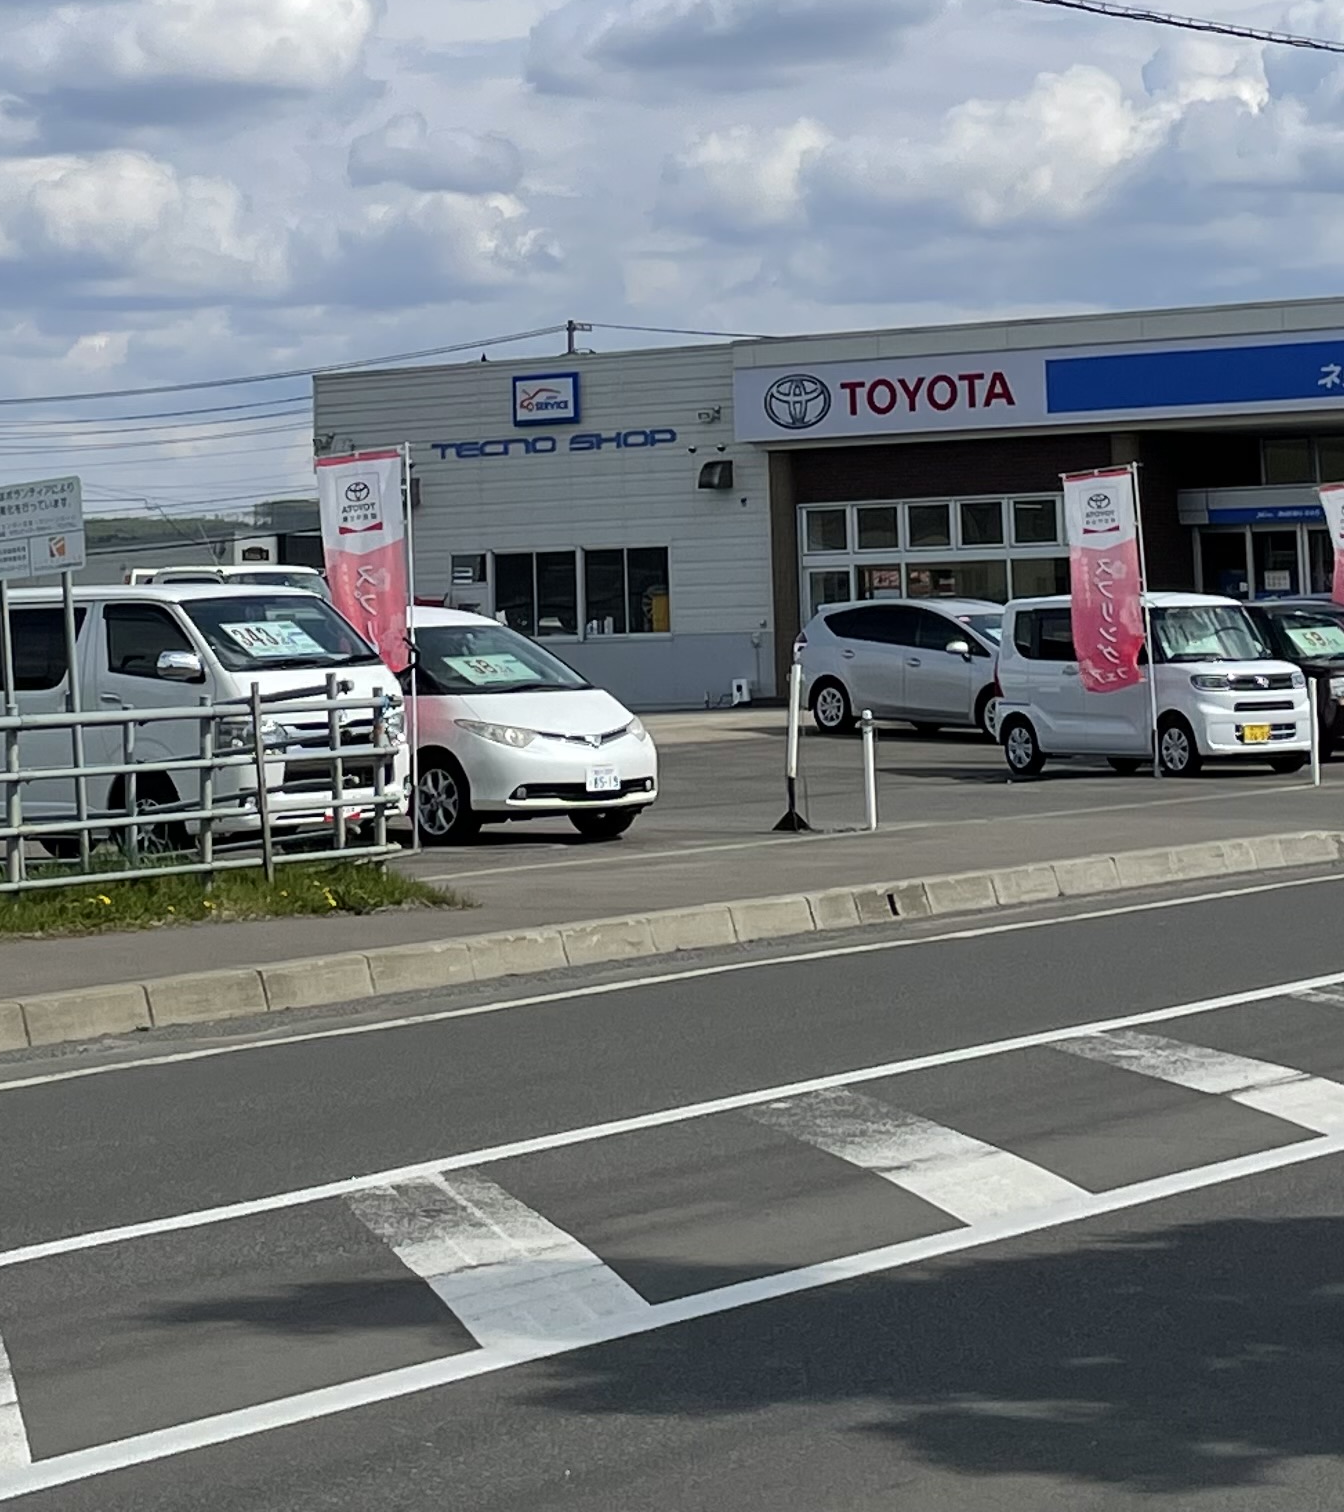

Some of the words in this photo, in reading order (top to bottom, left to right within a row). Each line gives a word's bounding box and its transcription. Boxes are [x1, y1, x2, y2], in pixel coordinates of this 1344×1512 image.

[840, 372, 1016, 416] TOYOTA
[431, 436, 557, 460] TECNO
[568, 428, 678, 452] SHOP
